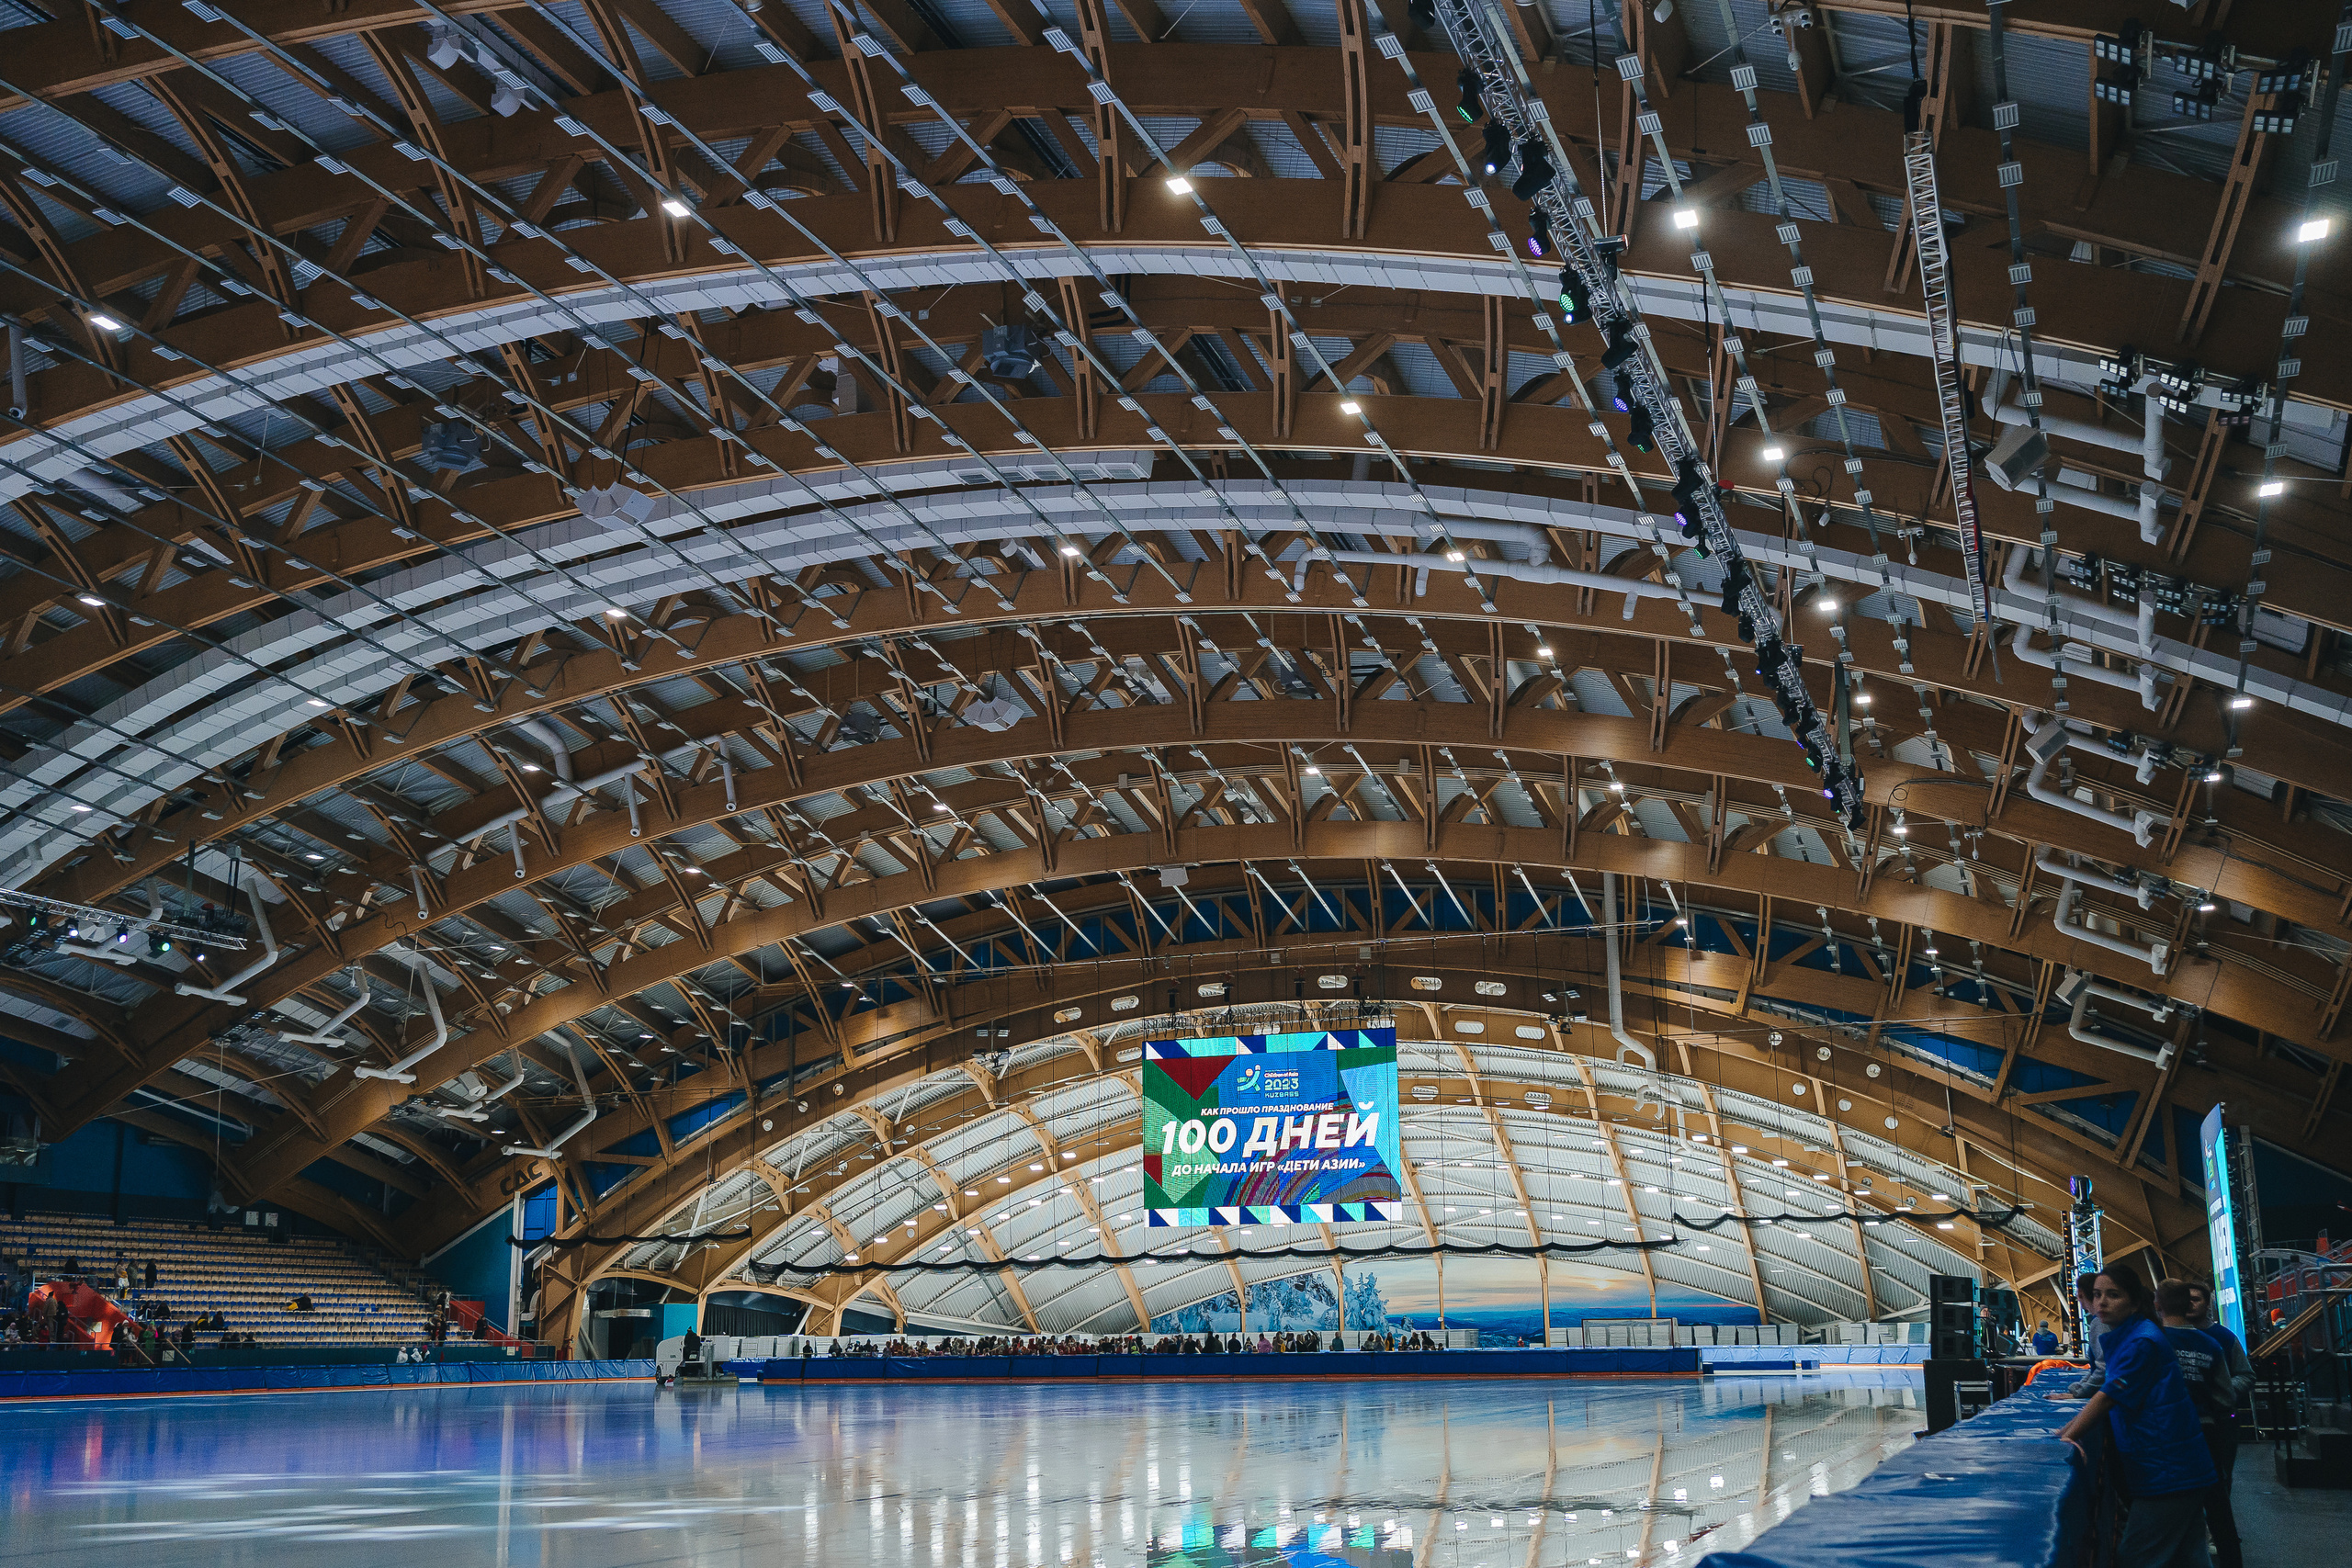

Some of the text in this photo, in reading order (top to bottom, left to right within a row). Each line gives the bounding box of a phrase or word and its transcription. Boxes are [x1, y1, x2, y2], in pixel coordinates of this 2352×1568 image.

[1264, 1077, 1299, 1091] 2023
[1264, 1090, 1299, 1099] KUZBASS
[1201, 1102, 1334, 1116] КАК ПРОШЛО ПРАЗДНОВАНИЕ
[1161, 1100, 1380, 1158] 100 ДНЕЙ
[1171, 1157, 1366, 1178] ДО НАЧАЛА ИГР «ДЕТИ АЗИИ»
